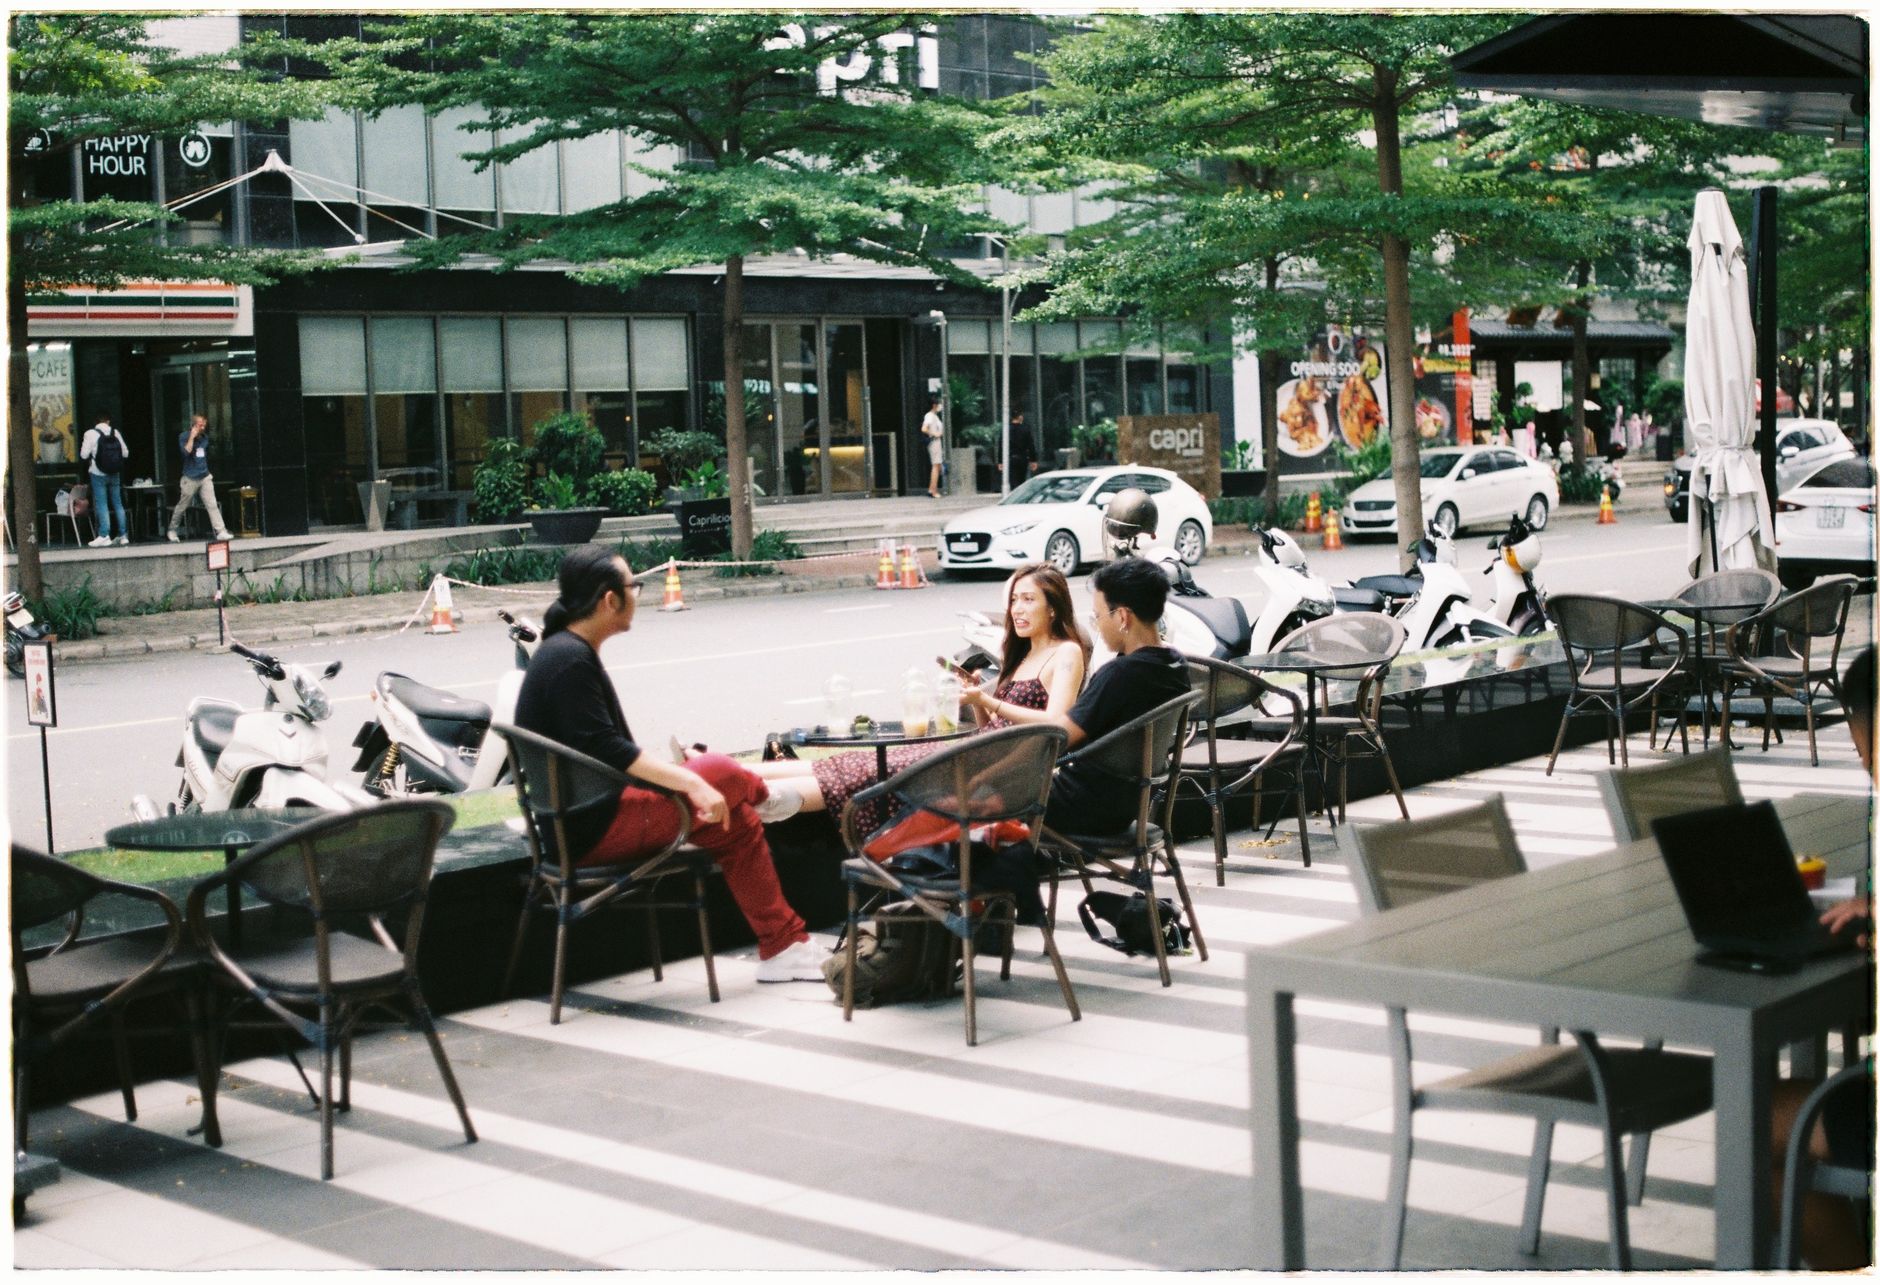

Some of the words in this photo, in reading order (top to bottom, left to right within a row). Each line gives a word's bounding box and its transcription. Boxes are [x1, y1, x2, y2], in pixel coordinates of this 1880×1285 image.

[85, 134, 150, 154] HAPPY
[90, 155, 147, 176] HOUR
[1290, 361, 1337, 377] OPENING
[1339, 361, 1361, 376] SOO
[1149, 422, 1204, 455] capri
[688, 513, 733, 527] Caprilicio
